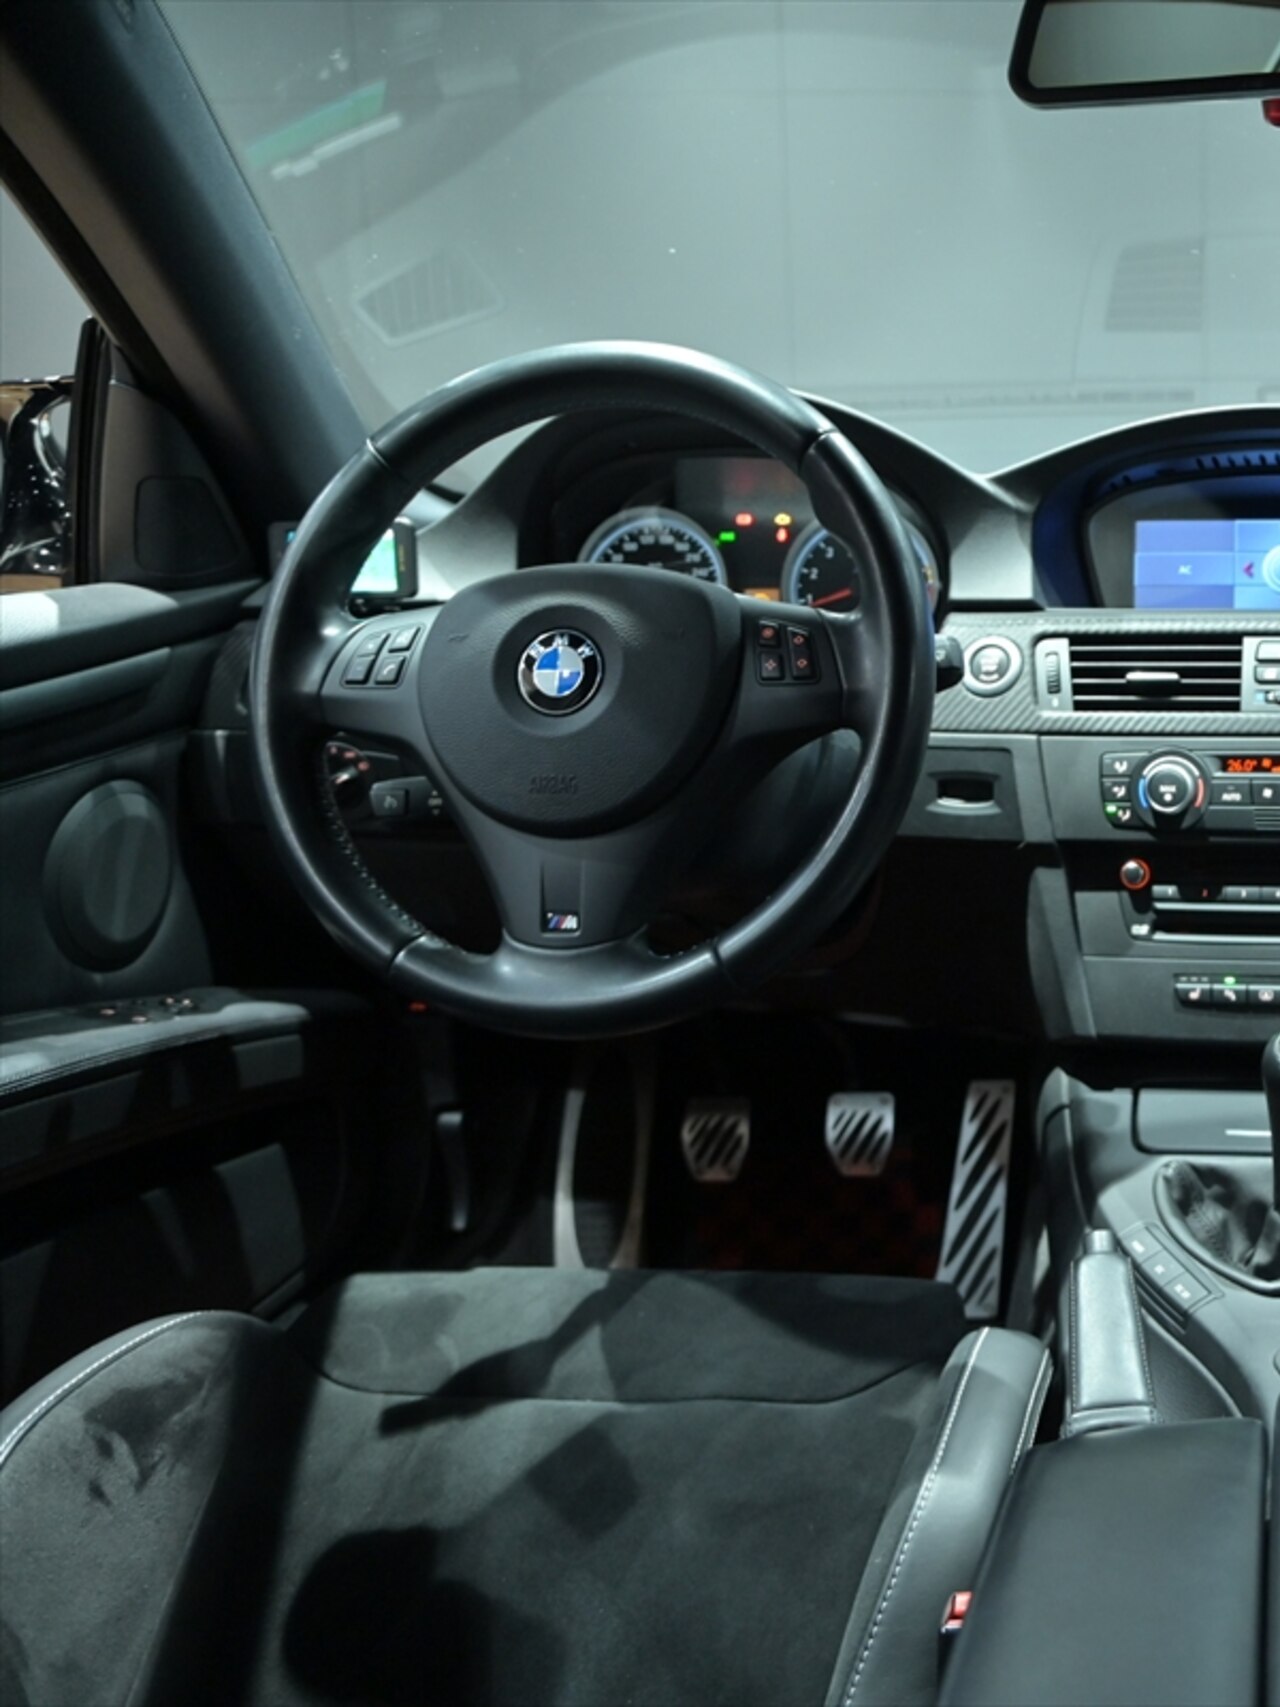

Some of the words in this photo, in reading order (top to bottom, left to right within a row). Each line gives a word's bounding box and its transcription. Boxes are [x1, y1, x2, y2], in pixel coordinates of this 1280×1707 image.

[809, 567, 818, 579] 2
[528, 634, 594, 658] BMW
[1221, 792, 1242, 801] AUTO
